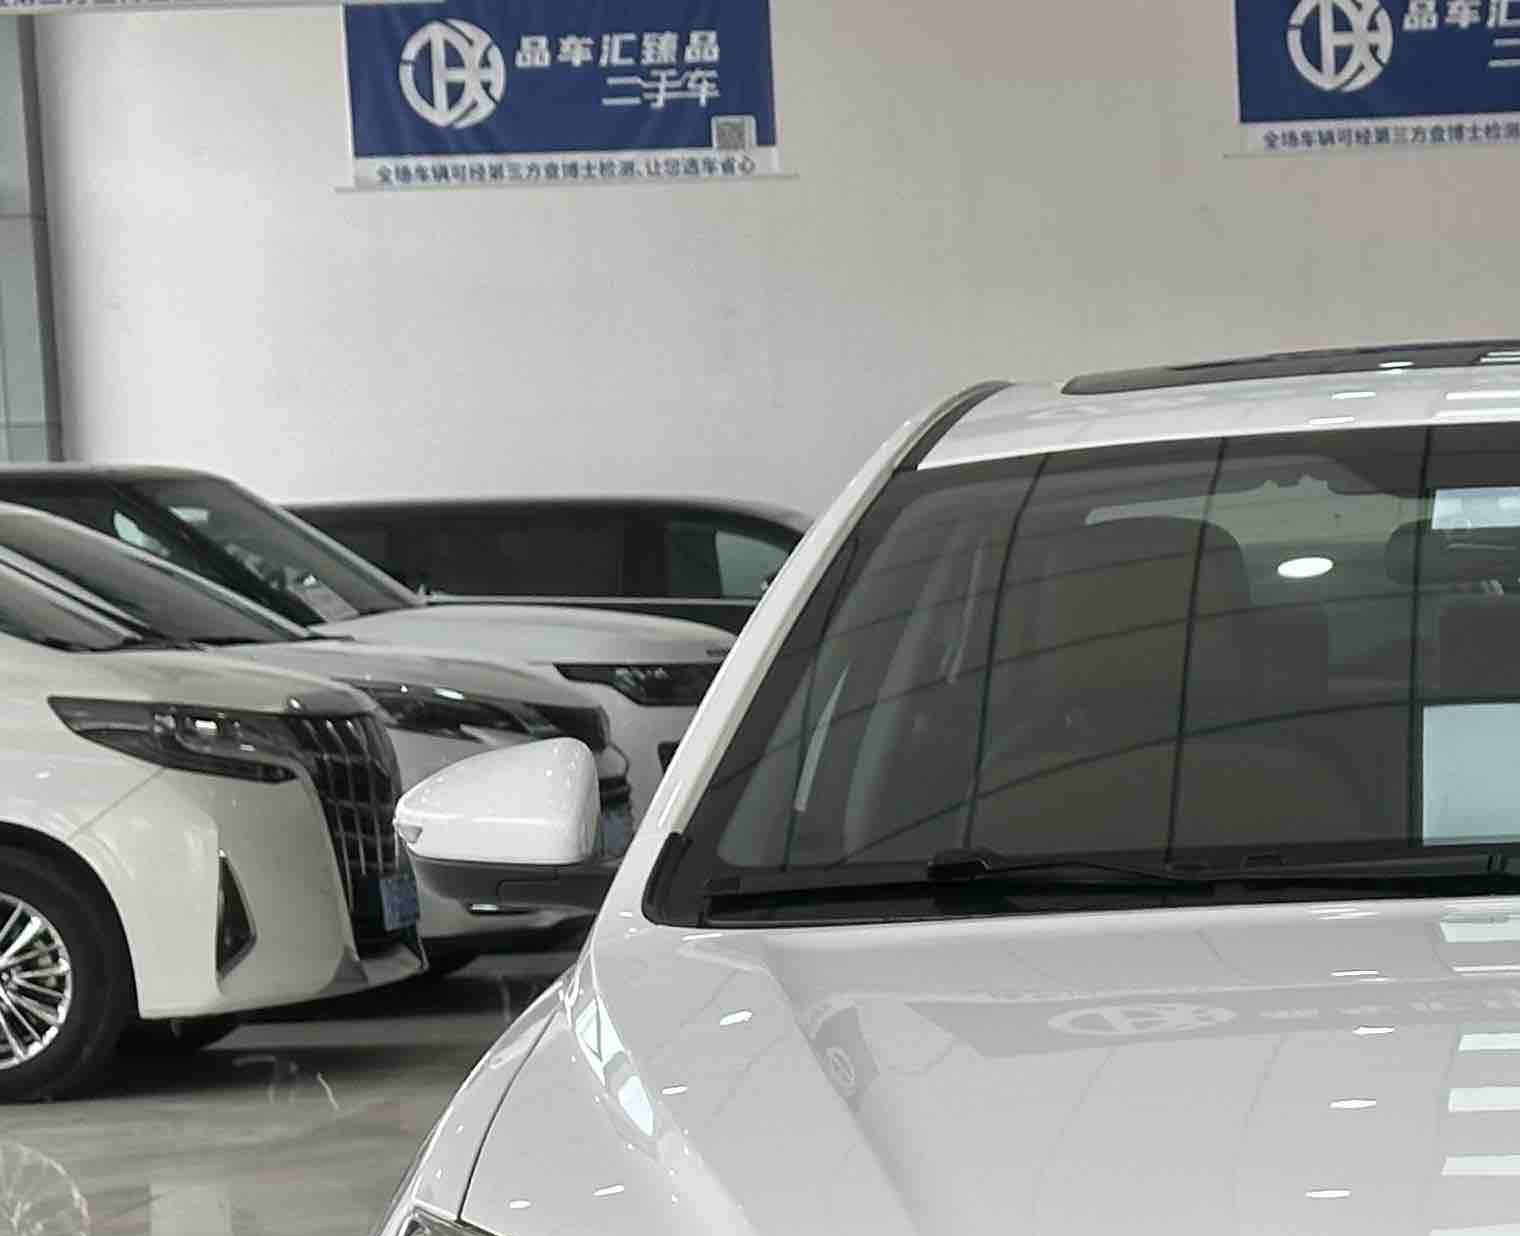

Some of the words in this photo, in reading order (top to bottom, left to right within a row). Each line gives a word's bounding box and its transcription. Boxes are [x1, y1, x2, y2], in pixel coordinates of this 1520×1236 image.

[514, 30, 720, 68] 品车汇臻品
[601, 69, 720, 108] 二手车
